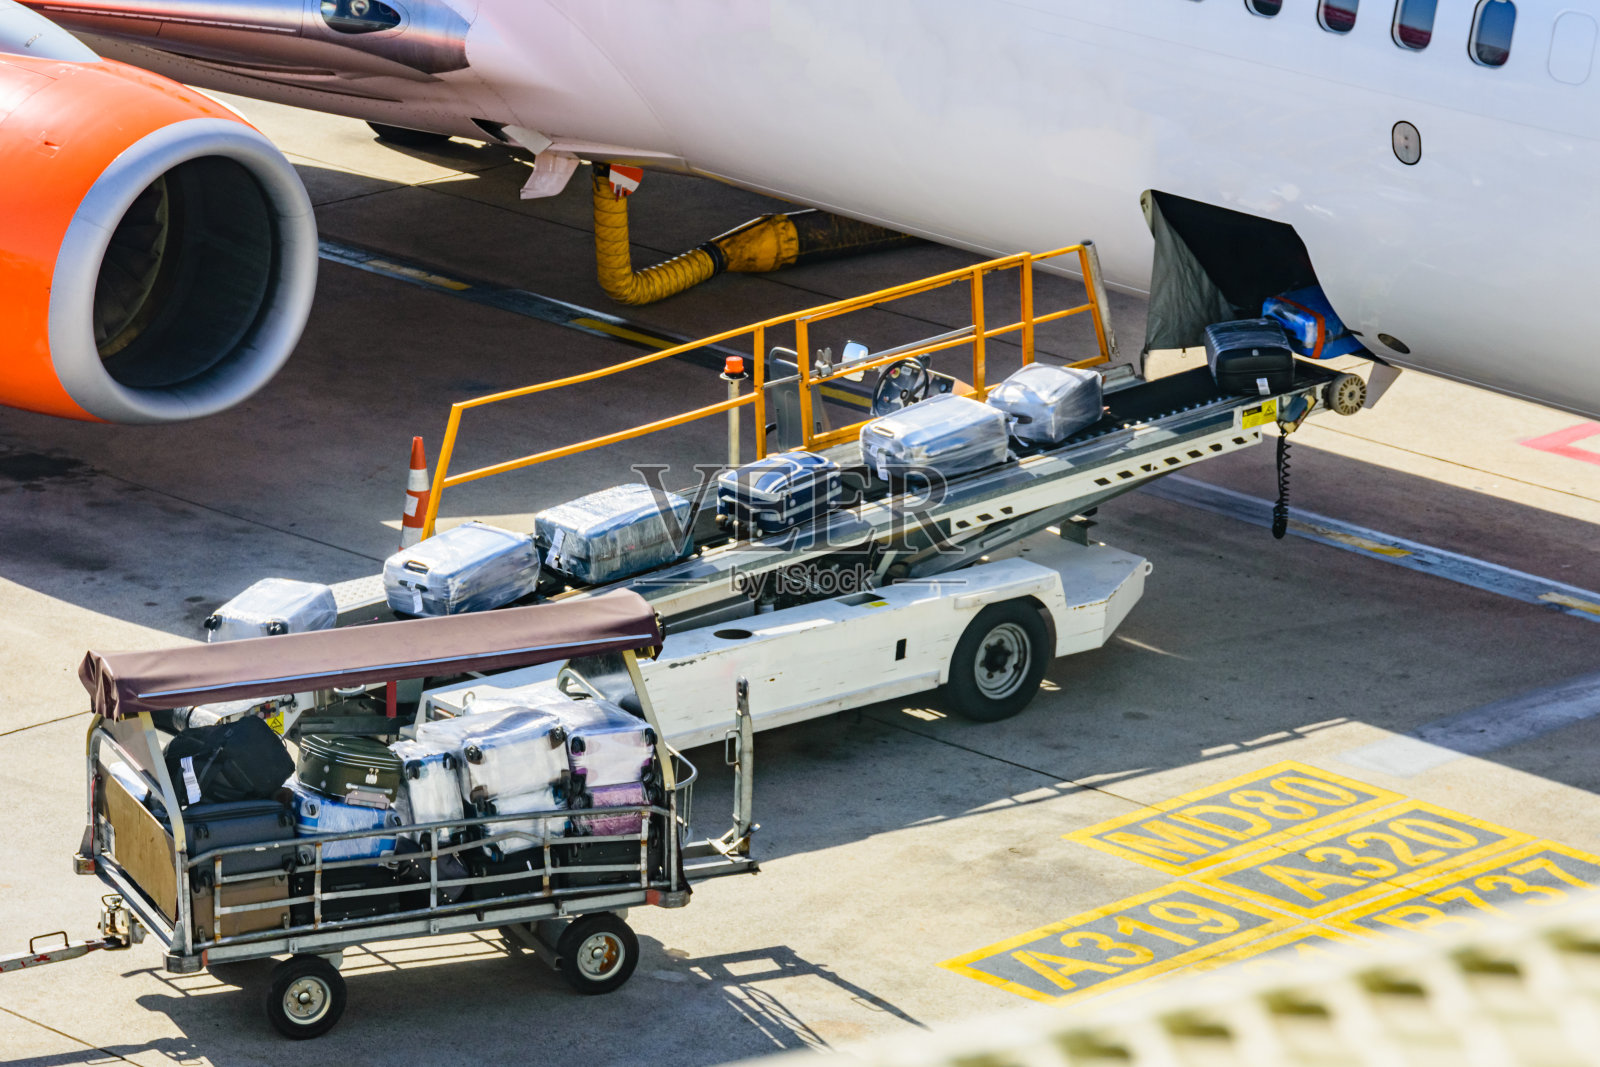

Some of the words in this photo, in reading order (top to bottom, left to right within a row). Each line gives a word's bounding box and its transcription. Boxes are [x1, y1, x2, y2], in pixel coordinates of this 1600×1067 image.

[1103, 776, 1358, 863] MD80
[1258, 818, 1480, 902] A320
[1010, 901, 1240, 991] A319
